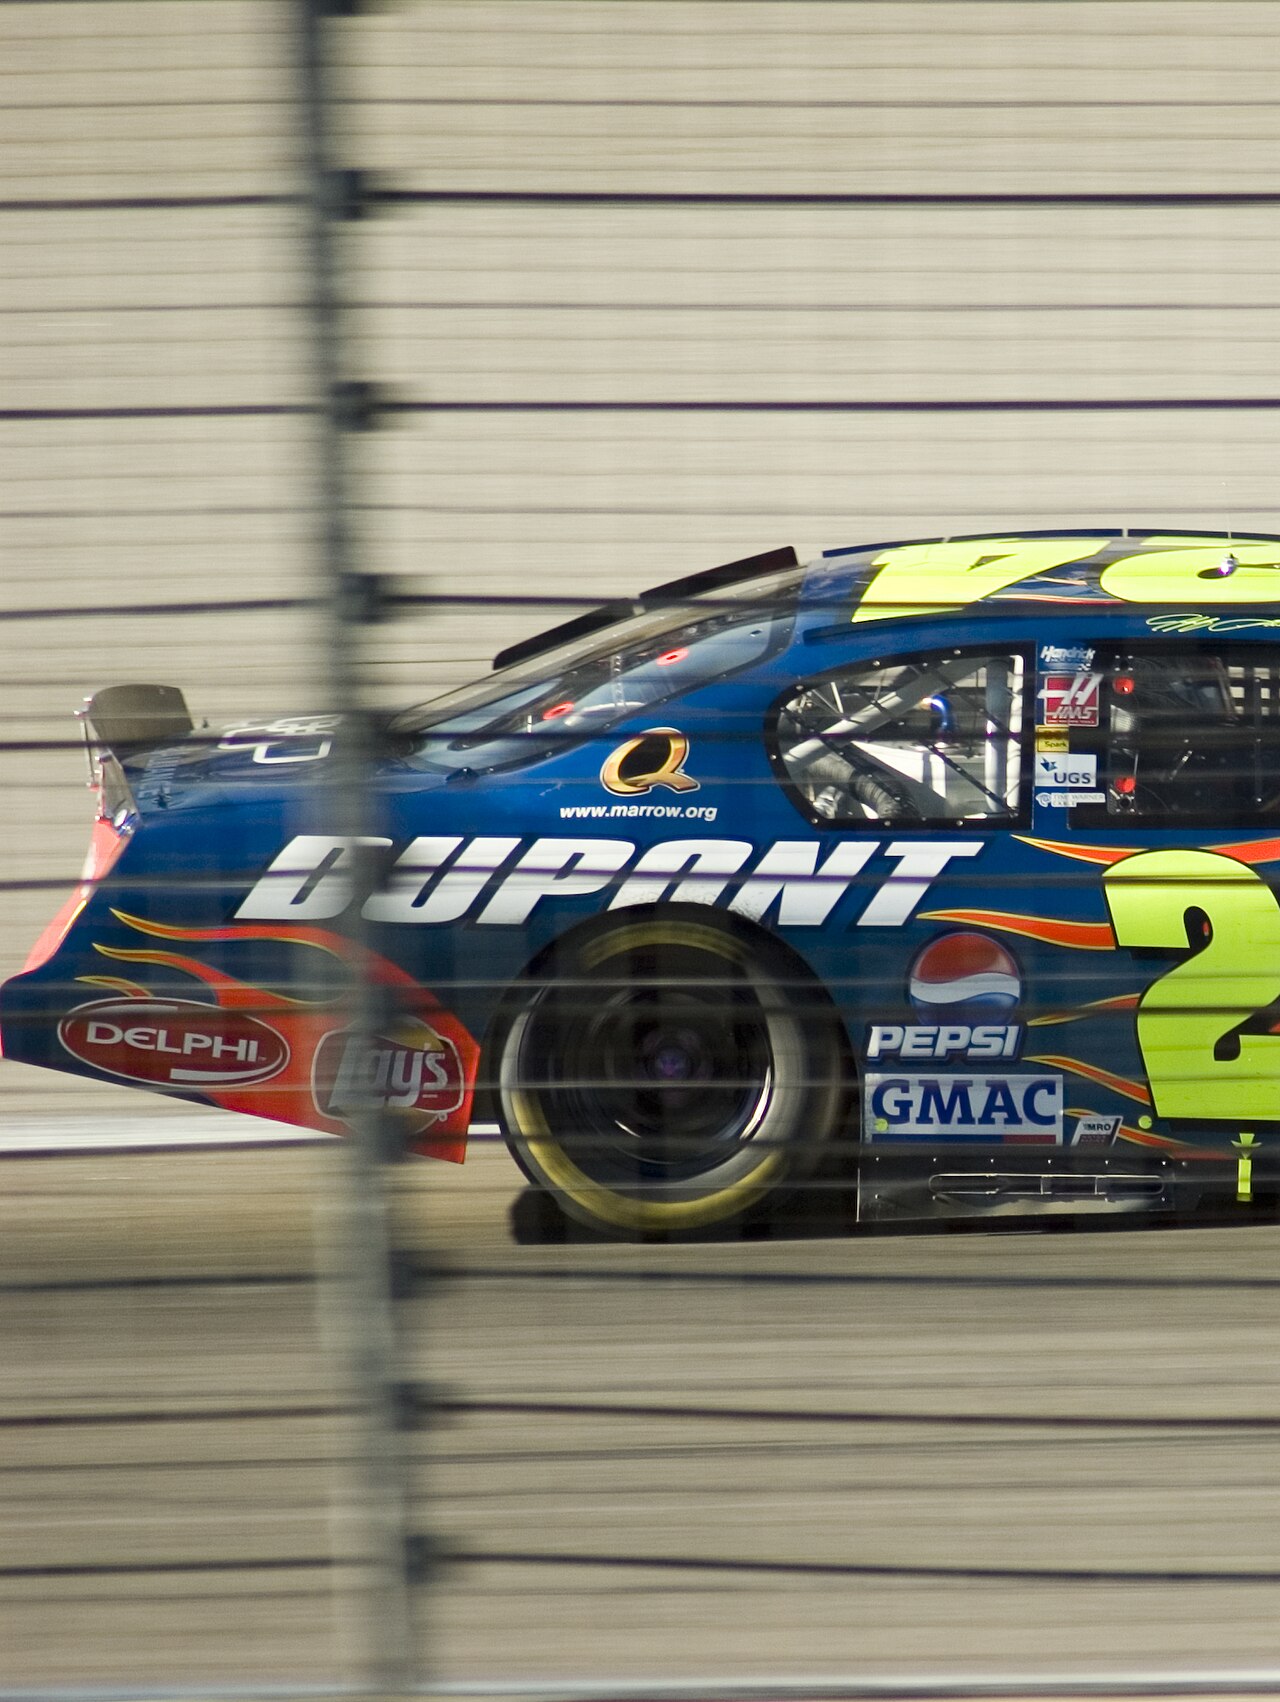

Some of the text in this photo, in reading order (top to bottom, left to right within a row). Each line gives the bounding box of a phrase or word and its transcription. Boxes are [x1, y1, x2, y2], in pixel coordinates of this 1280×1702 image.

[1040, 645, 1096, 662] Hendrick
[600, 727, 700, 796] Q
[1054, 772, 1091, 784] UGS
[559, 802, 718, 821] www.marrow.org
[234, 835, 985, 927] DUPONT
[86, 1021, 259, 1062] DELPHI
[867, 1025, 1020, 1058] PEPSI
[872, 1078, 1057, 1127] GMAC
